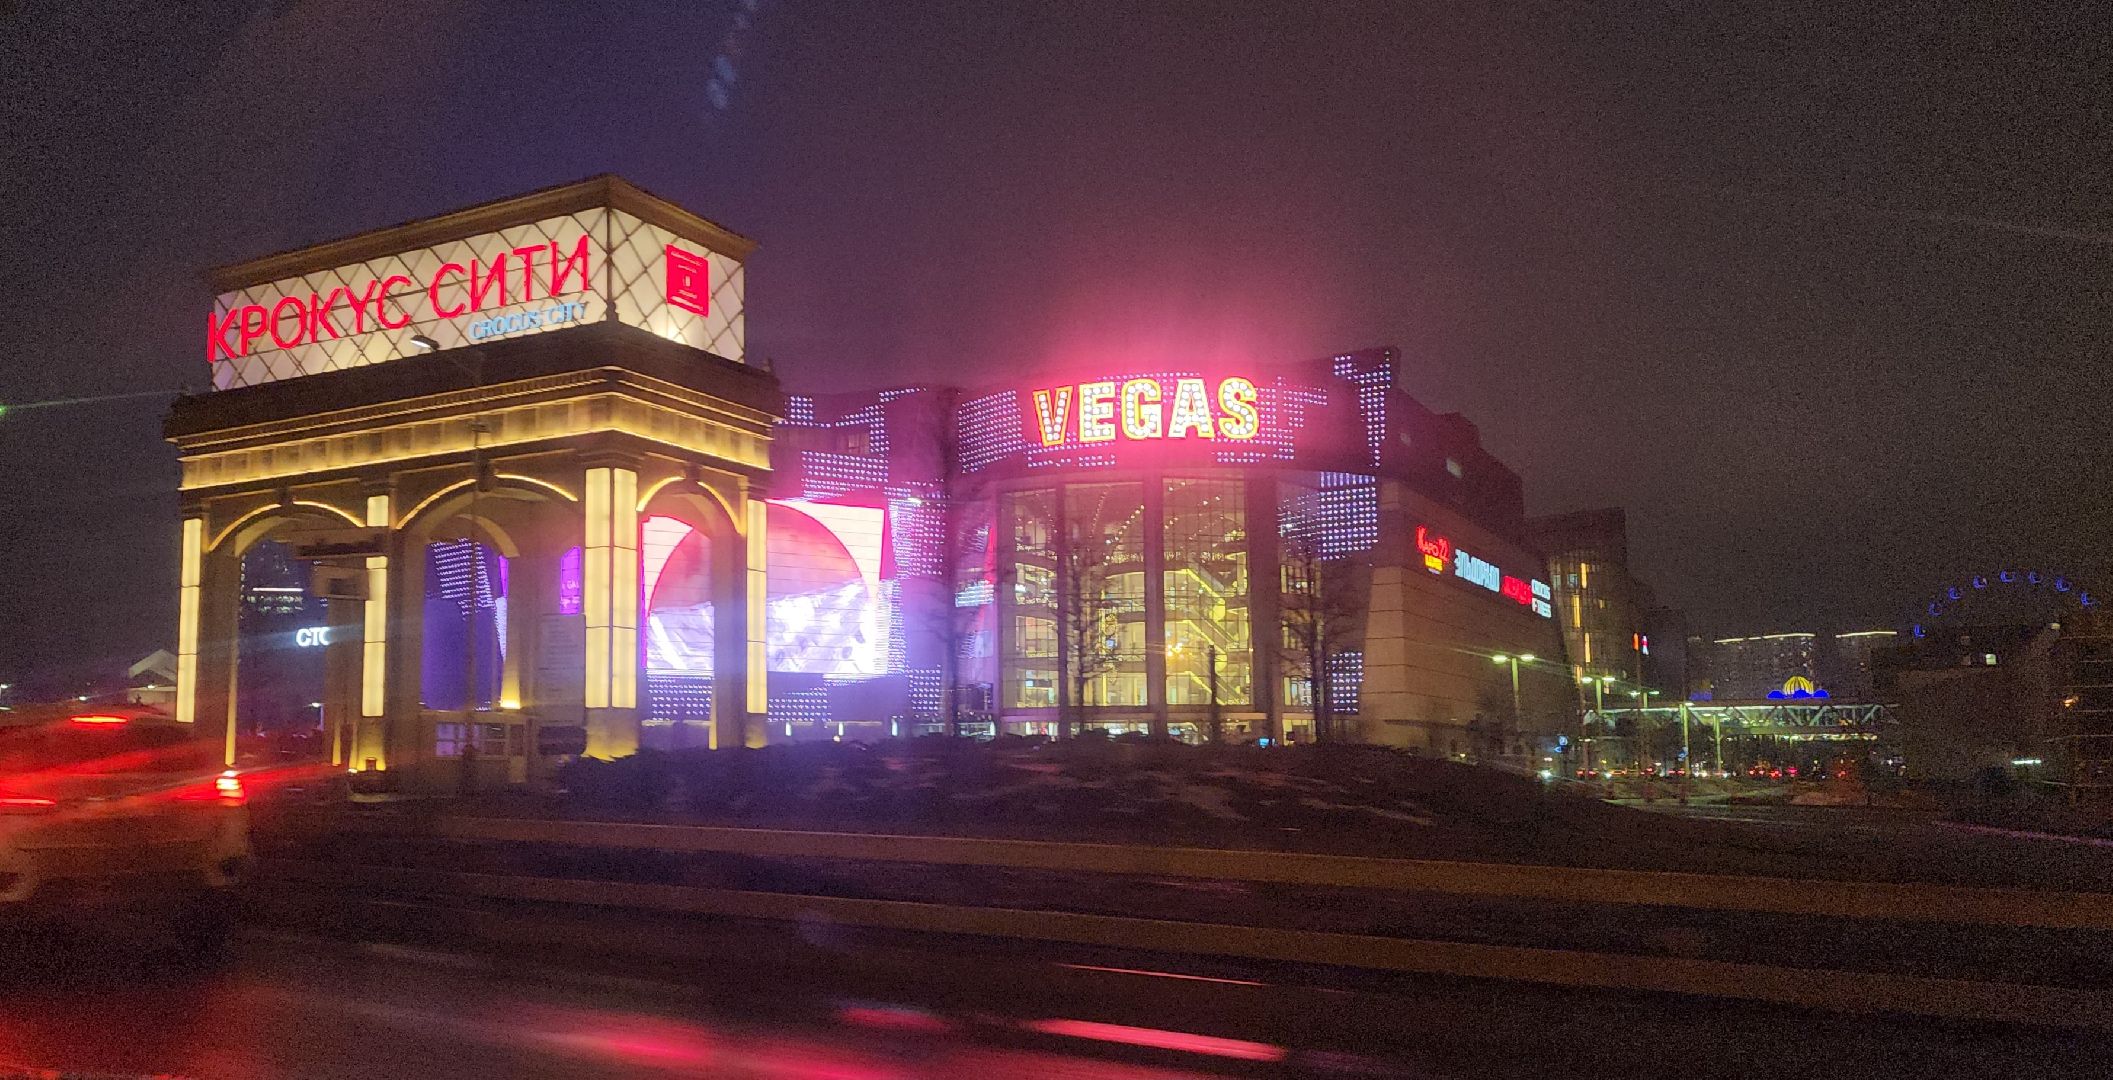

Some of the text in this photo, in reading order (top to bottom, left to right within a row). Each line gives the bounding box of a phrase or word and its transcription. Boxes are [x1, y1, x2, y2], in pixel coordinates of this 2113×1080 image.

[206, 275, 411, 362] КРОКУС
[428, 235, 589, 319] СИТИ
[468, 300, 590, 340] CROCUS CITY
[1033, 377, 1260, 447] VEGAS
